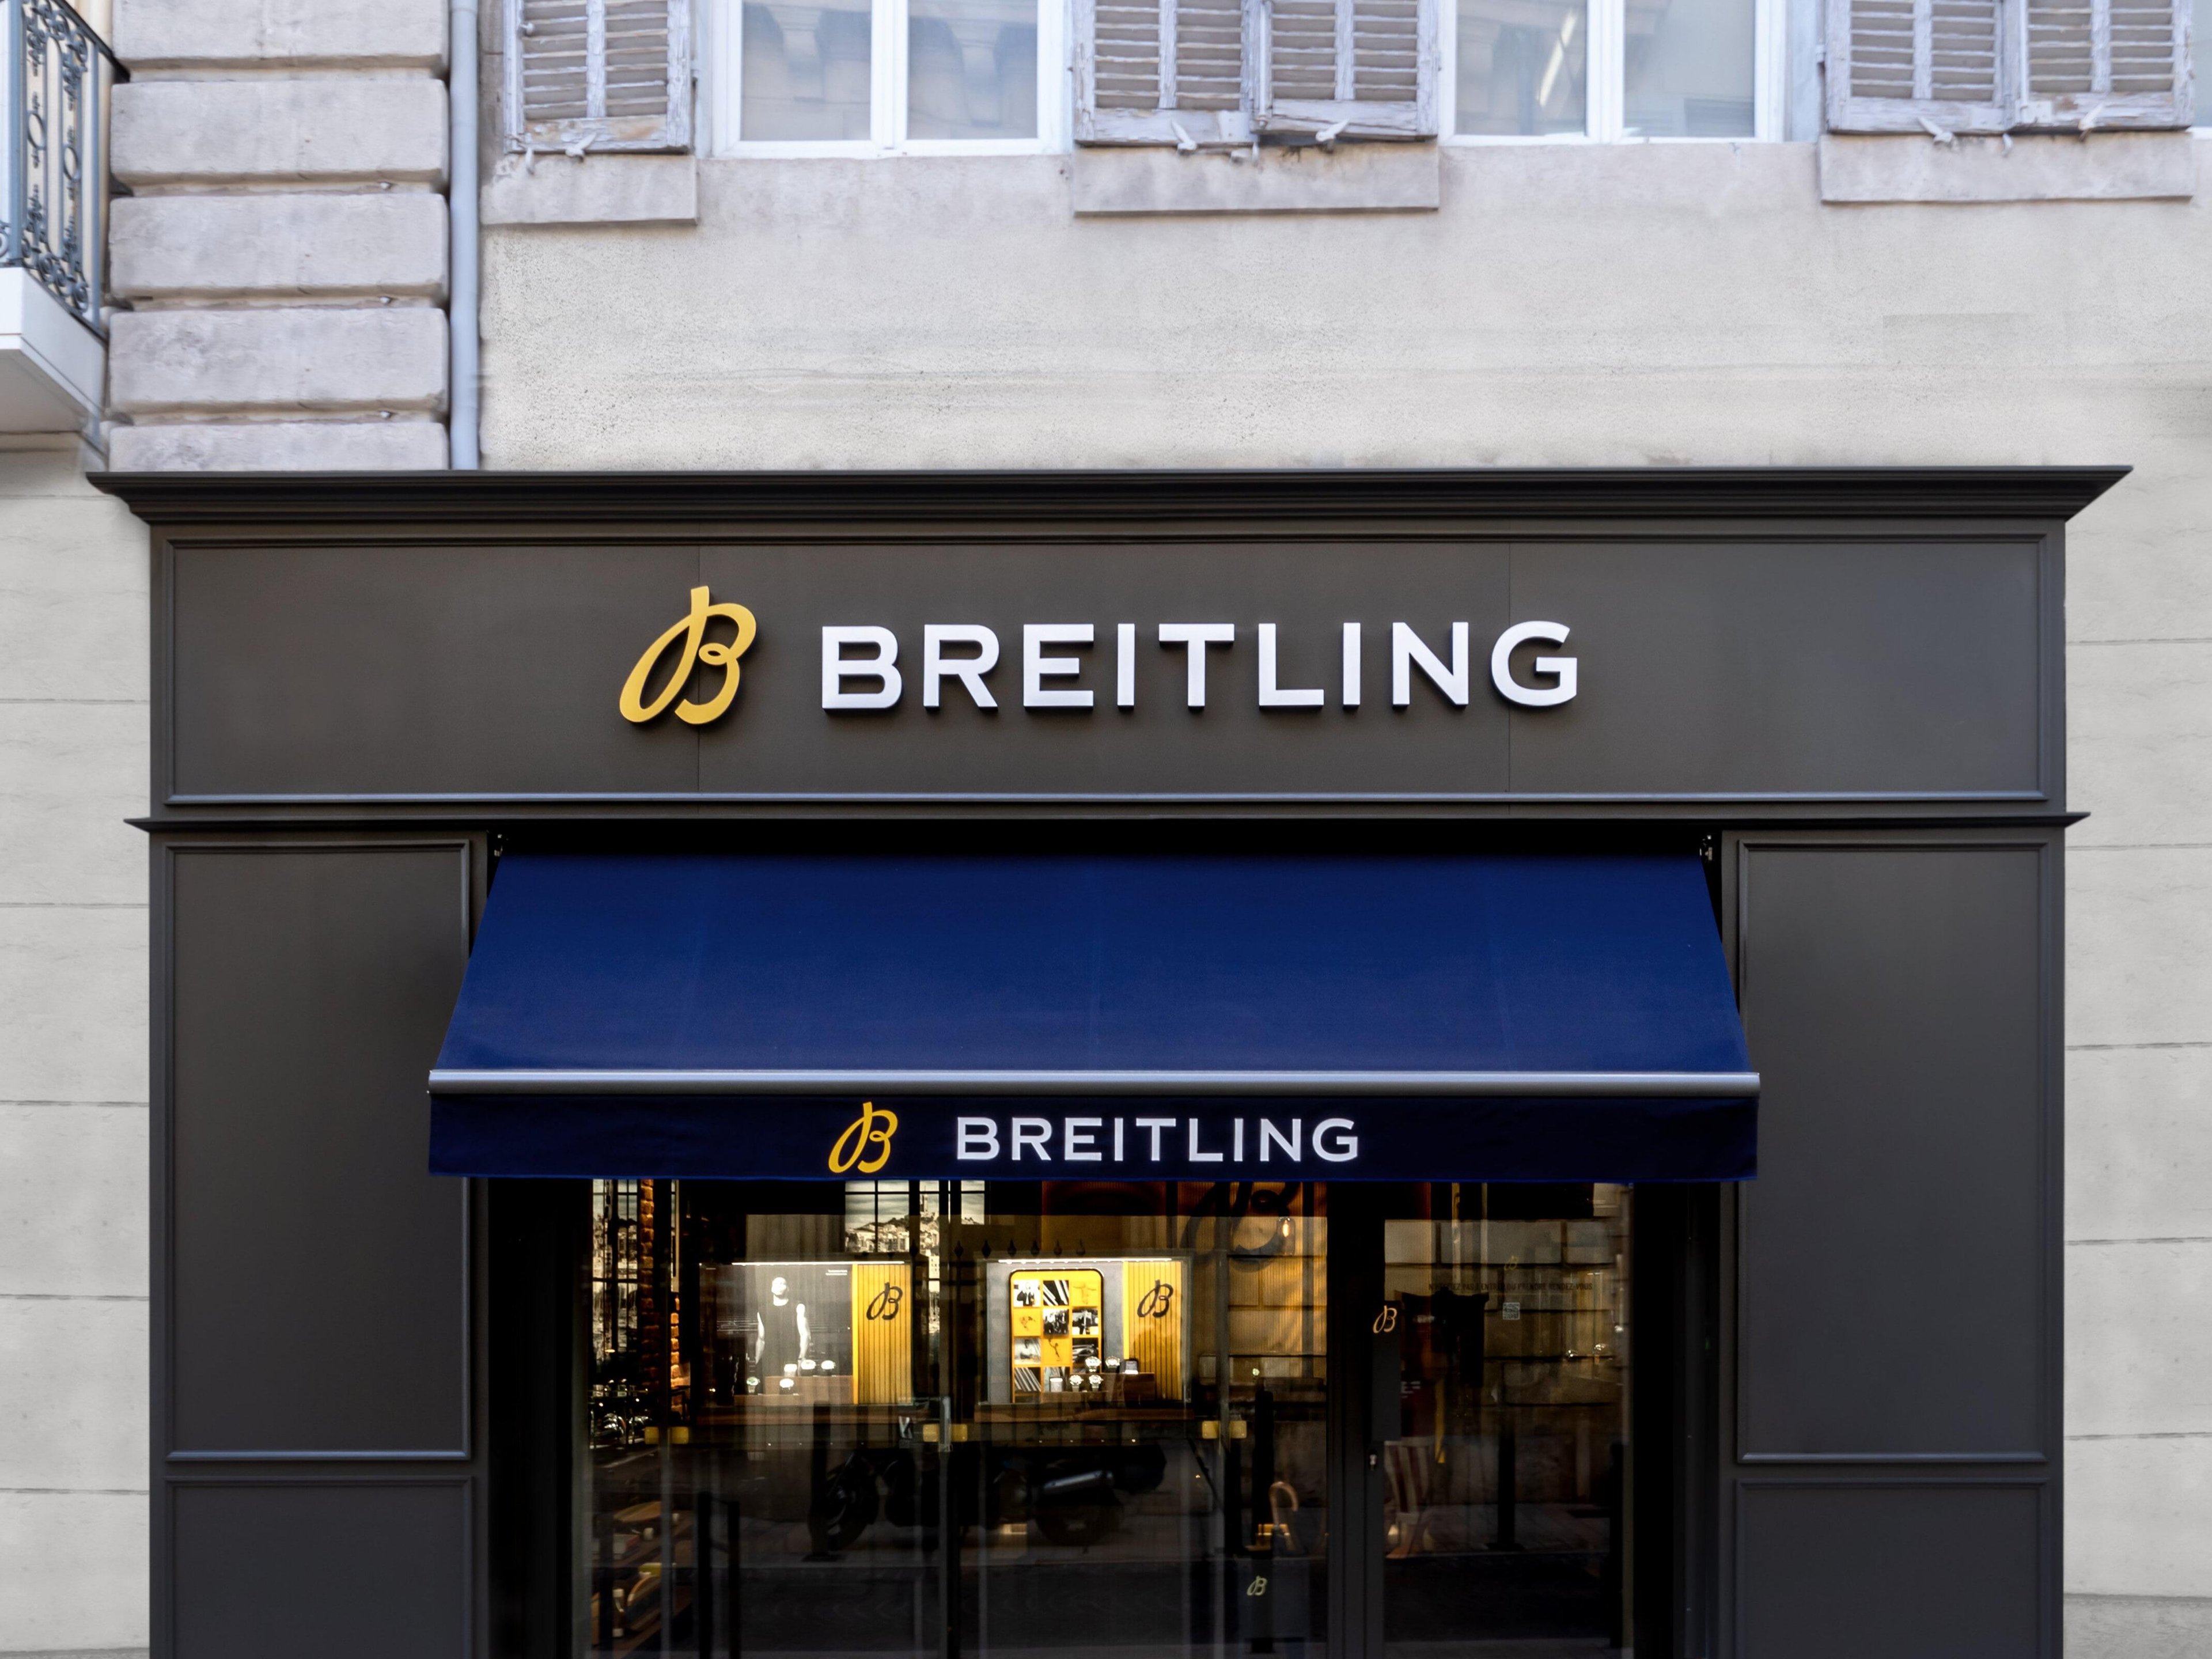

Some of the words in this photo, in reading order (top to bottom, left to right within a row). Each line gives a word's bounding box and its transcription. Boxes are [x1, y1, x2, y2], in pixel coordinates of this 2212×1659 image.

[619, 586, 756, 725] B
[821, 620, 1578, 709] BREITLING
[828, 1101, 898, 1173] B
[957, 1117, 1358, 1162] BREITLING
[866, 1282, 903, 1320] B
[1137, 1279, 1173, 1318] B
[1373, 1305, 1397, 1334] B
